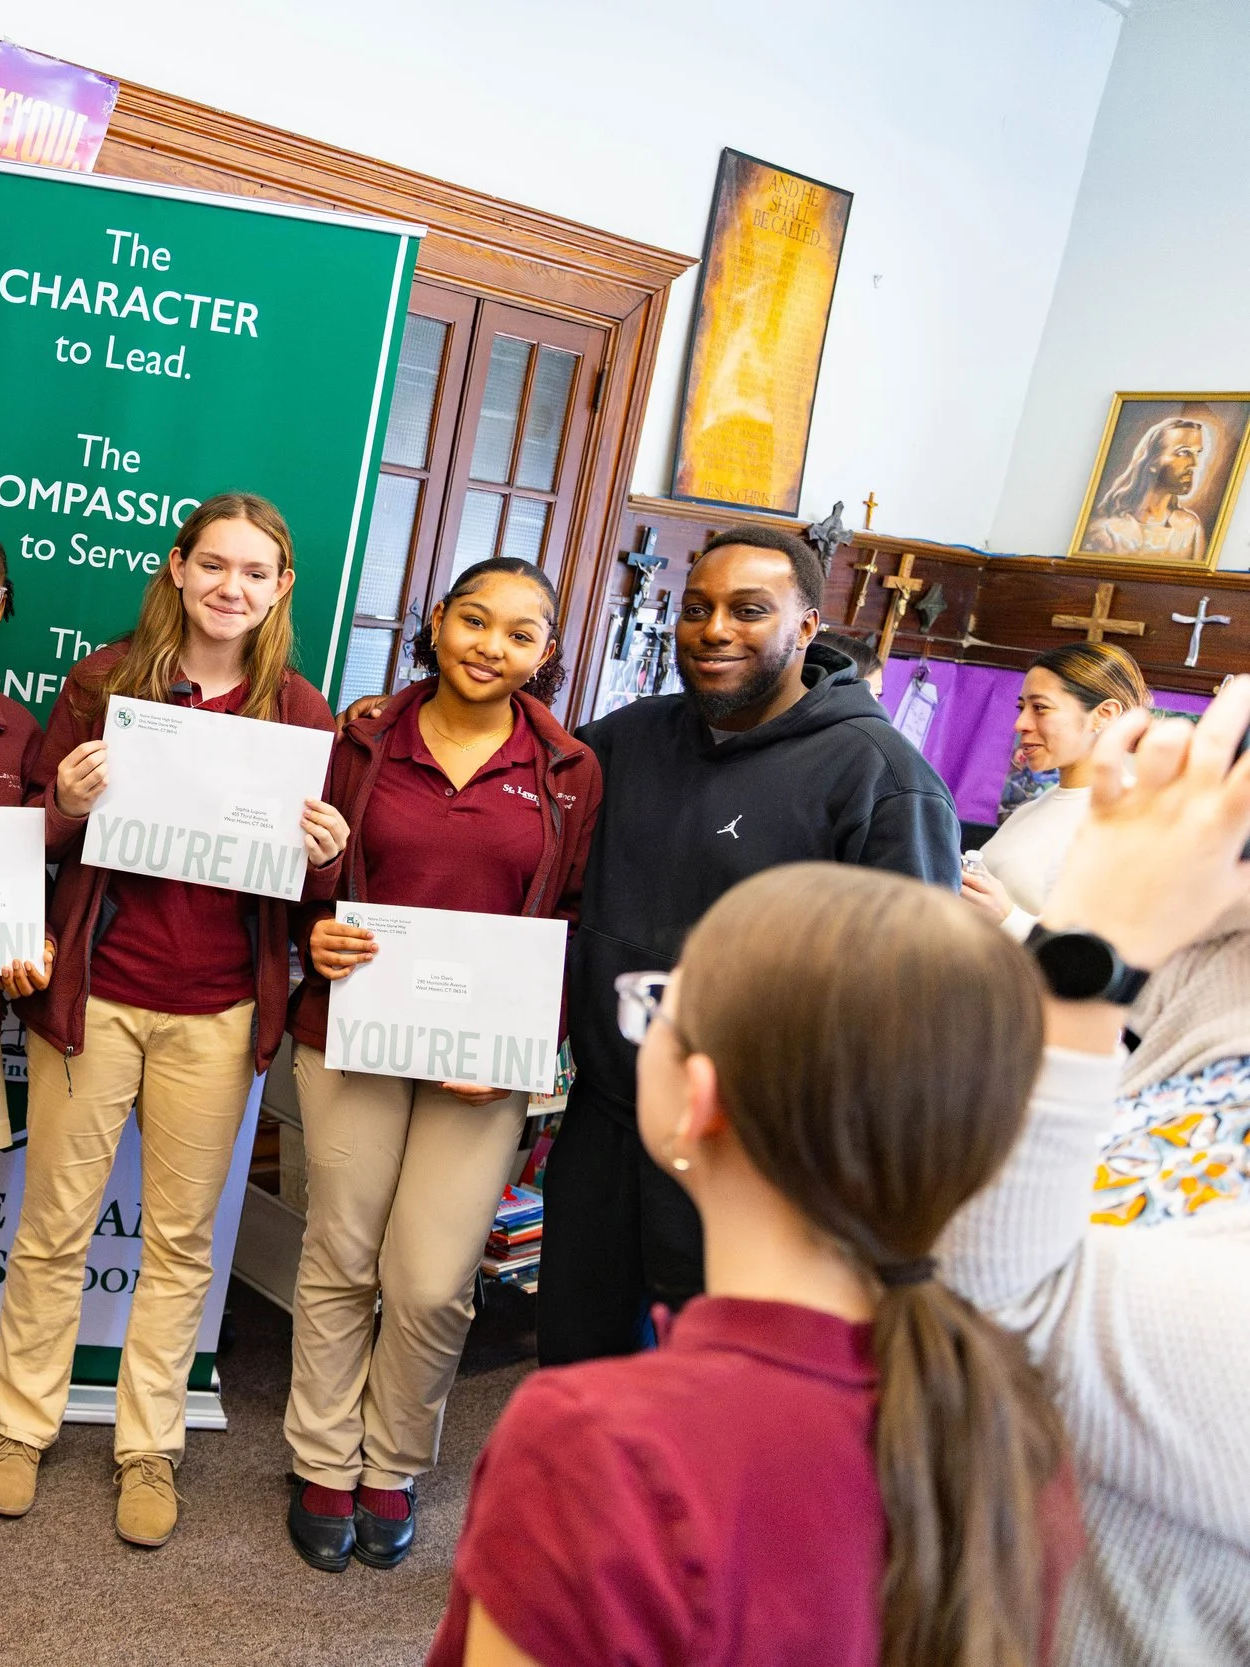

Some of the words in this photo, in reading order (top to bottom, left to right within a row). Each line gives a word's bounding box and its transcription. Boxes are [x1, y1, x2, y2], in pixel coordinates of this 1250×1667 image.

[768, 174, 800, 198] AND
[801, 184, 822, 208] HE
[769, 194, 810, 224] SHALL
[752, 208, 770, 230] BE
[105, 229, 172, 272] The
[55, 336, 92, 364] to
[105, 335, 192, 380] Lead.
[77, 433, 142, 474] The
[702, 481, 736, 502] JESUS
[737, 488, 778, 510] CHRIST
[20, 533, 56, 562] to
[98, 813, 238, 884] YOU'RE
[242, 840, 302, 896] IN!
[336, 1017, 480, 1080] YOU'RE
[491, 1034, 548, 1088] IN!
